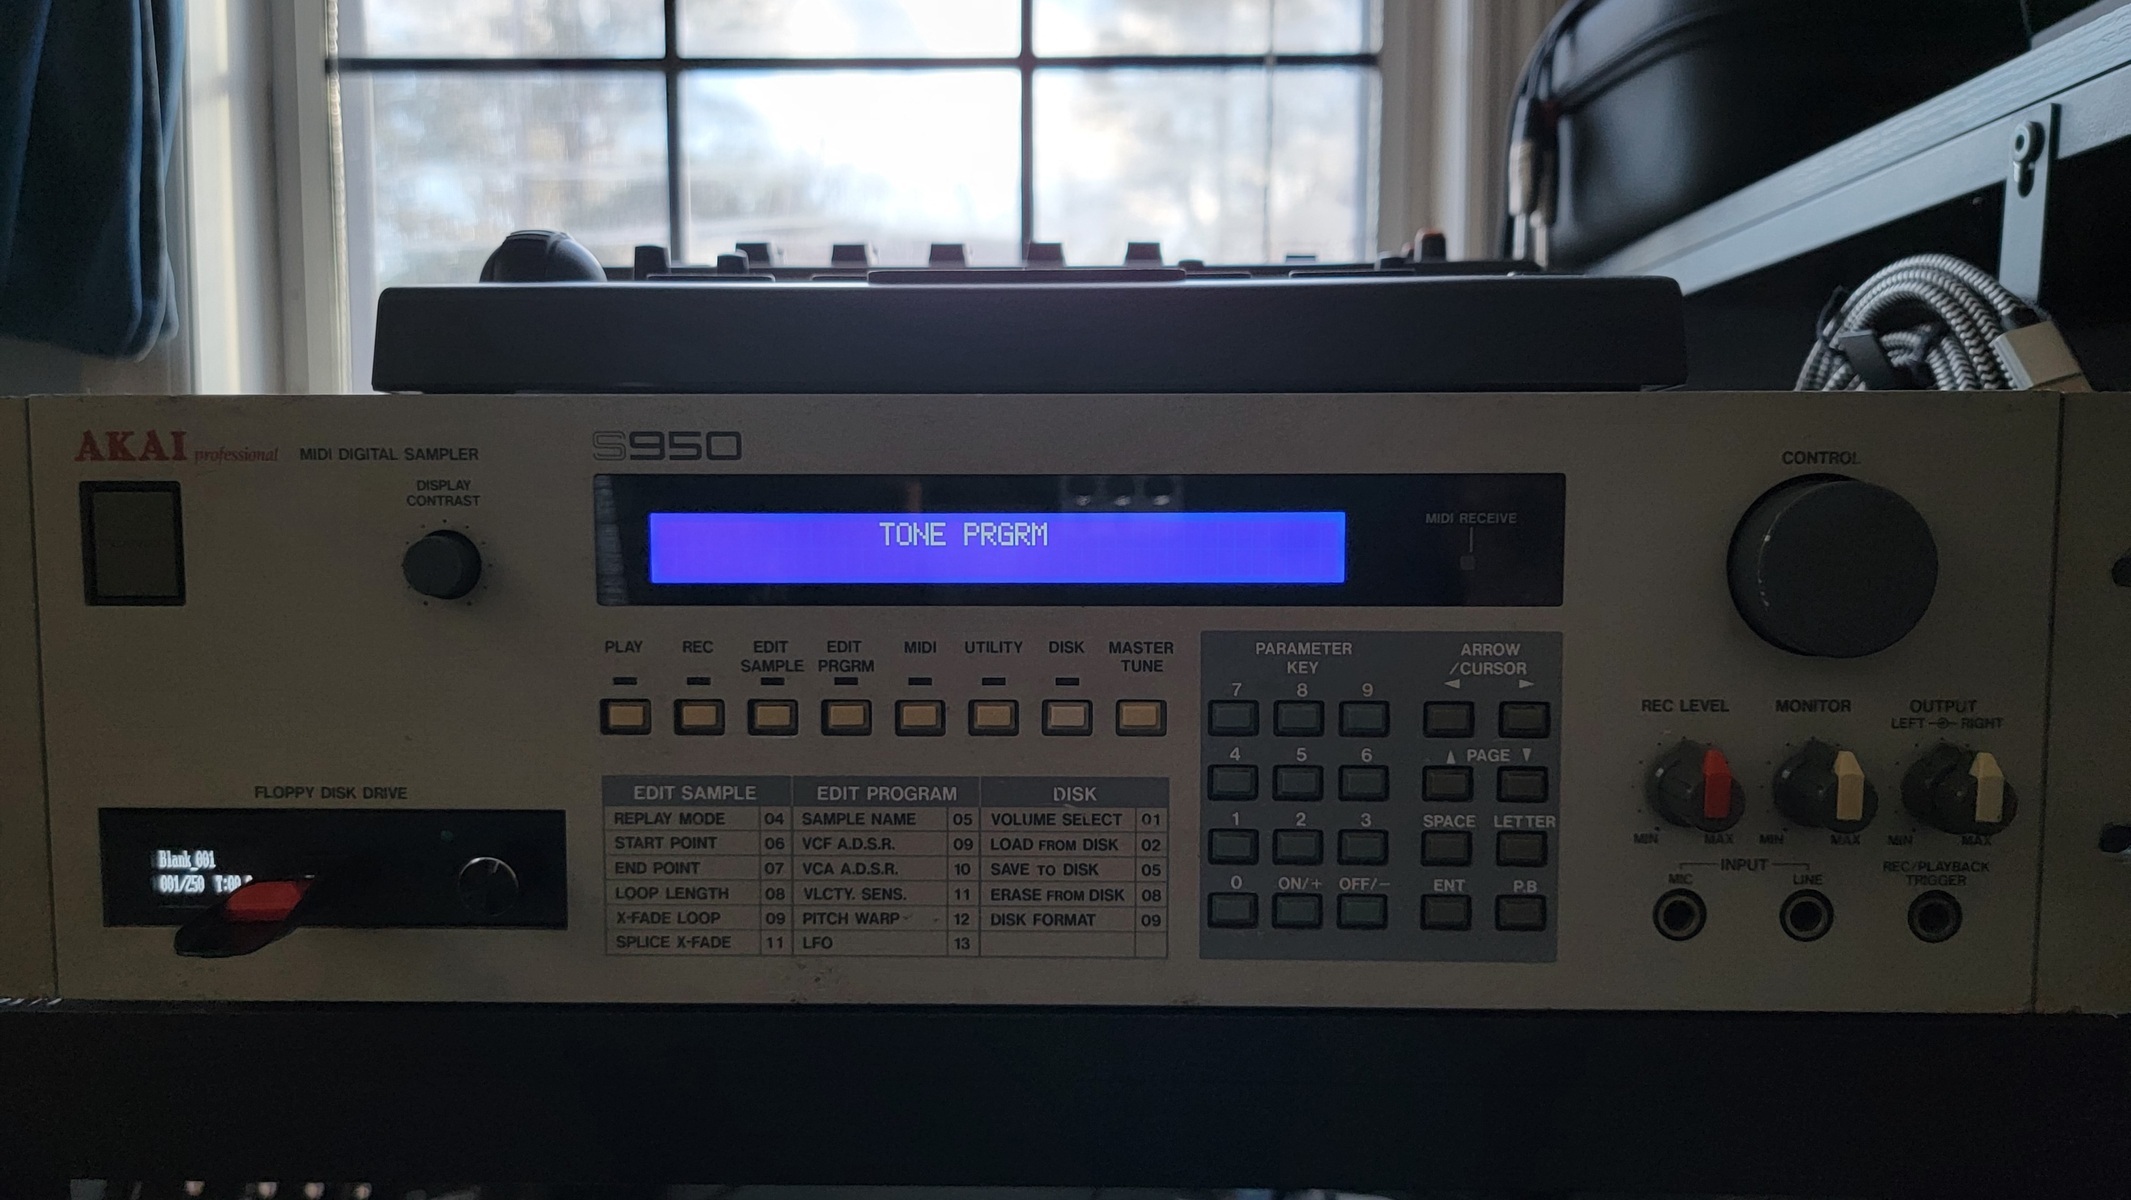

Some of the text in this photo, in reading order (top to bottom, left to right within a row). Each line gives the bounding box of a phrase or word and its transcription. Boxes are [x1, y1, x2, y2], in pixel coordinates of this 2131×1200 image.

[74, 430, 279, 465] AKAI professional
[592, 431, 743, 461] S950
[300, 448, 479, 461] MIDI DIGITAL SAMPLER
[1782, 451, 1861, 465] CONTROL
[416, 480, 472, 491] DISPLAY
[406, 495, 481, 507] CONTRAST
[1425, 512, 1517, 524] MIDI RECEIVE
[879, 522, 1049, 547] TONE PRGRM
[605, 641, 643, 654] PLAY
[682, 641, 714, 654] REC
[753, 641, 788, 654] EDIT
[827, 641, 862, 654] EDIT
[904, 641, 938, 654] MIDI
[964, 641, 1023, 654] UTILITY
[1049, 641, 1085, 654] DISK
[1109, 641, 1174, 655] MASTER
[1255, 642, 1353, 656] PARAMETER
[1460, 643, 1521, 657] ARROW
[741, 659, 804, 673] SAMPLE
[818, 660, 875, 673] PRGRM
[1121, 660, 1164, 673] TUNE
[1287, 661, 1319, 675] KEY
[1449, 661, 1528, 676] /CURSOR
[1232, 683, 1242, 697] 7
[1297, 683, 1308, 697] 8
[1362, 683, 1374, 698] 9
[1641, 700, 1730, 713] REC LEVEL
[1775, 700, 1851, 713] MONITOR
[1910, 700, 1977, 714] OUTPUT
[1891, 717, 2003, 729] LEFT RIGHT
[1229, 747, 1241, 762] 4
[1296, 748, 1307, 762] 5
[1361, 748, 1373, 762] 6
[1467, 748, 1511, 762] PAGE
[254, 786, 407, 800] FLOPPY DISK DRIVE
[634, 786, 757, 800] EDIT SAMPLE
[817, 786, 957, 801] EDIT PROGRAM
[1053, 787, 1097, 801] DISK
[614, 812, 726, 825] REPLAY MODE
[764, 813, 785, 826] 04
[802, 813, 917, 826] SAMPLE NAME
[953, 813, 973, 826] 05
[991, 813, 1123, 826] VOLUME SELECT
[1141, 813, 1161, 826] 01
[1232, 813, 1240, 827] 1
[1296, 812, 1307, 827] 2
[1361, 813, 1372, 827] 3
[1423, 815, 1476, 829] SPACE
[1494, 815, 1556, 829] LETTER
[614, 836, 717, 849] START POINT
[764, 837, 785, 850] 06
[802, 837, 896, 850] VCF A.D.S.R.
[953, 838, 974, 851] 09
[990, 838, 1119, 851] LOAD FROM DISK
[1634, 833, 1659, 844] MIN
[1704, 833, 1734, 844] MAX
[1759, 833, 1784, 844] MIN
[1831, 833, 1861, 844] MAX
[1888, 833, 1914, 845] MIN
[1962, 833, 1992, 845] MAX
[1141, 839, 1161, 852] 02
[158, 850, 217, 872] Blank_001
[1720, 858, 1769, 872] INPUT
[1883, 861, 1990, 873] REC/PLAYBACK
[614, 861, 701, 875] END POINT
[764, 862, 784, 875] 07
[803, 862, 899, 875] VCA A.D.S.R.
[954, 863, 971, 875] 10
[990, 863, 1100, 876] SAVE TO DISK
[1141, 863, 1162, 877] 05
[158, 874, 205, 894] 001/250
[1231, 876, 1242, 890] 0
[1278, 877, 1323, 891] ON/+
[1433, 879, 1466, 892] ENT
[1668, 873, 1693, 885] MIC
[1793, 873, 1823, 885] LINE
[1907, 874, 1967, 887] TRIGGER
[615, 886, 730, 900] LOOP LENGTH
[765, 887, 785, 901] 08
[803, 887, 907, 901] VLCTY. SENS.
[954, 888, 970, 901] 11
[990, 888, 1126, 902] ERASE FROM DISK
[1141, 889, 1162, 902] 08
[616, 911, 721, 925] X-FADE LOOP
[765, 911, 786, 925] 09
[802, 912, 901, 925] PITCH WARP
[953, 913, 970, 926] 12
[990, 913, 1097, 926] DISK FORMAT
[1141, 914, 1162, 927] 09
[615, 936, 732, 949] SPLICE X-FADE
[766, 936, 784, 949] 11
[802, 936, 834, 949] LFO
[954, 937, 971, 951] 13
